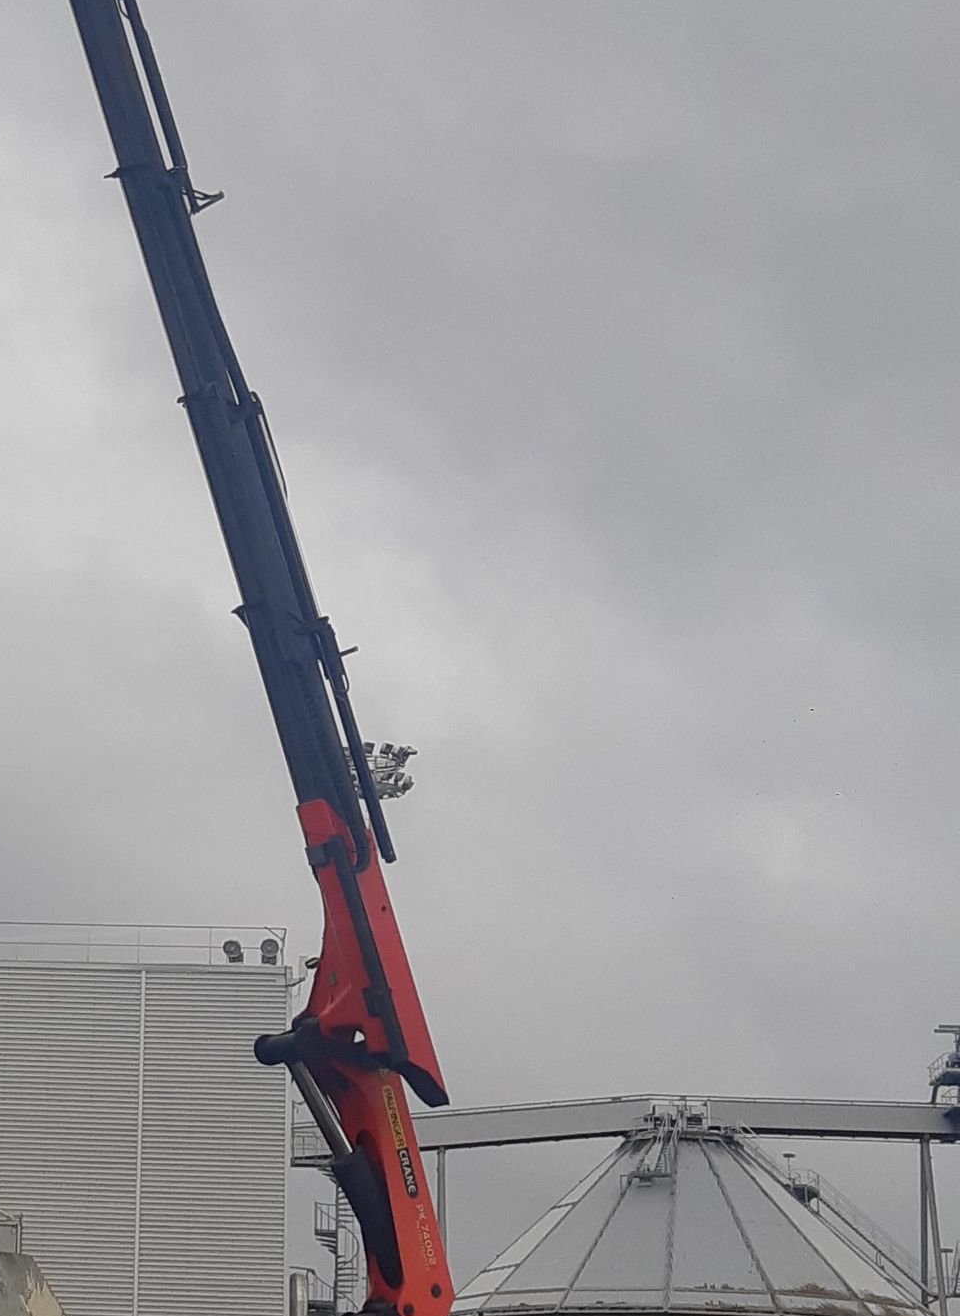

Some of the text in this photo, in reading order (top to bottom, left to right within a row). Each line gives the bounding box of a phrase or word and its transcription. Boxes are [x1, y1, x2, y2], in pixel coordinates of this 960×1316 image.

[384, 1087, 418, 1195] PALFINGER CRANE
[416, 1203, 426, 1221] PK
[420, 1224, 437, 1266] 74002
